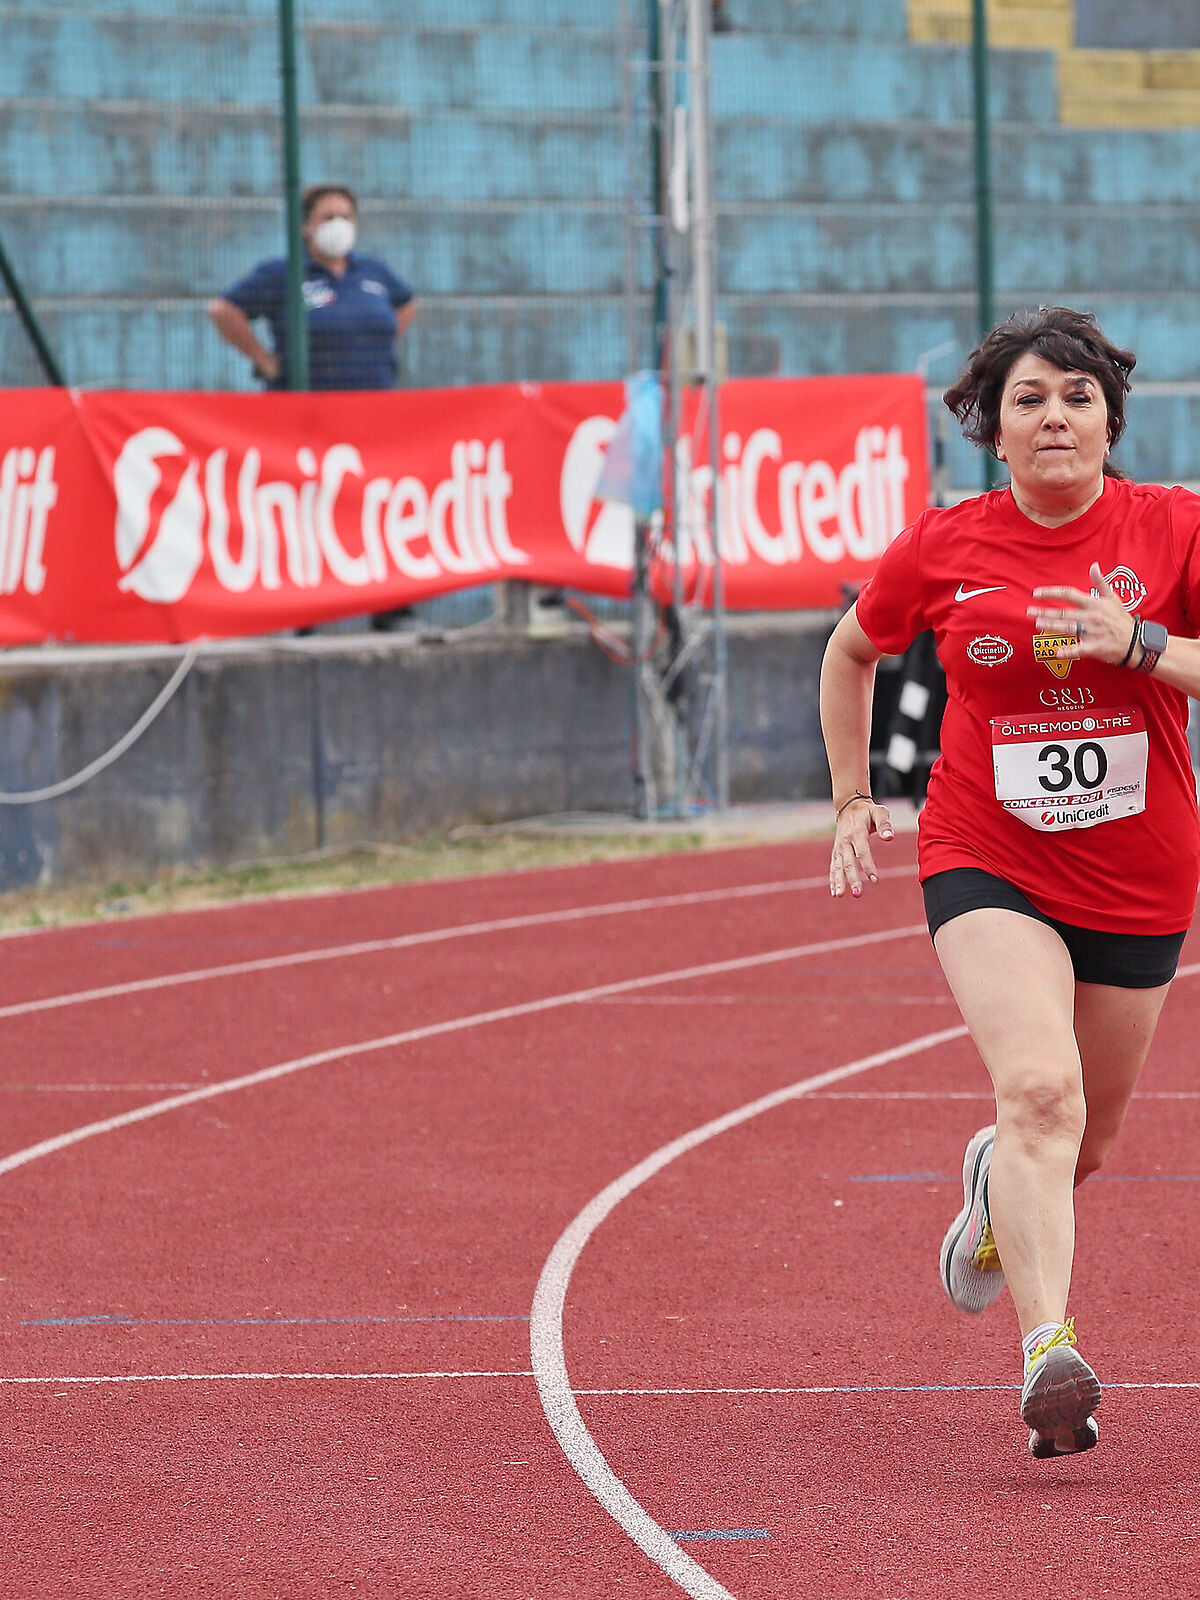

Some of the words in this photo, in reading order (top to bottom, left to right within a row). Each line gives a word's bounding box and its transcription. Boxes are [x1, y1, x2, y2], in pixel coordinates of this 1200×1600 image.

[204, 438, 532, 593] UniCredit
[1034, 638, 1077, 649] GRANA
[1039, 687, 1095, 706] G&B
[1038, 743, 1108, 792] 30
[1003, 796, 1069, 809] CONCESIO
[1070, 793, 1101, 804] 2021
[1056, 803, 1110, 824] UniCredit
